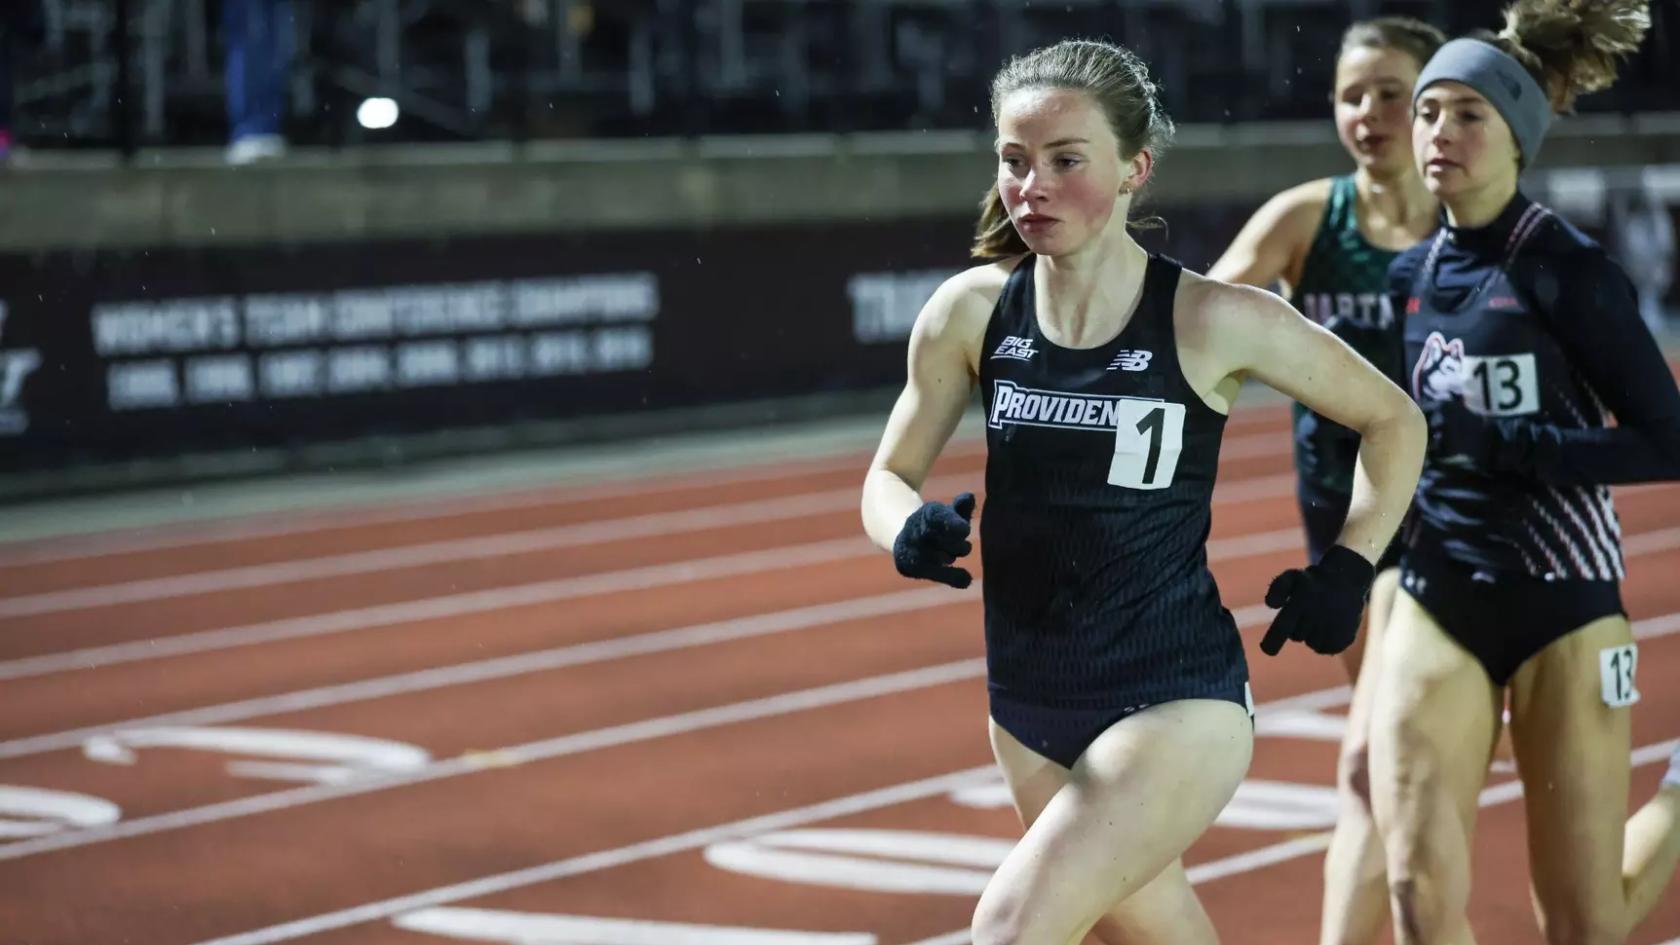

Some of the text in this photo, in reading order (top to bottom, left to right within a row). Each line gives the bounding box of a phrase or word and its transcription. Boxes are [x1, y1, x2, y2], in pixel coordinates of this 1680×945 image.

[994, 345, 1039, 358] EAST
[1001, 335, 1033, 349] BIG
[990, 383, 1120, 427] PROVIDEN
[1473, 360, 1523, 411] 13
[1136, 407, 1165, 485] 1
[1610, 648, 1633, 701] 13
